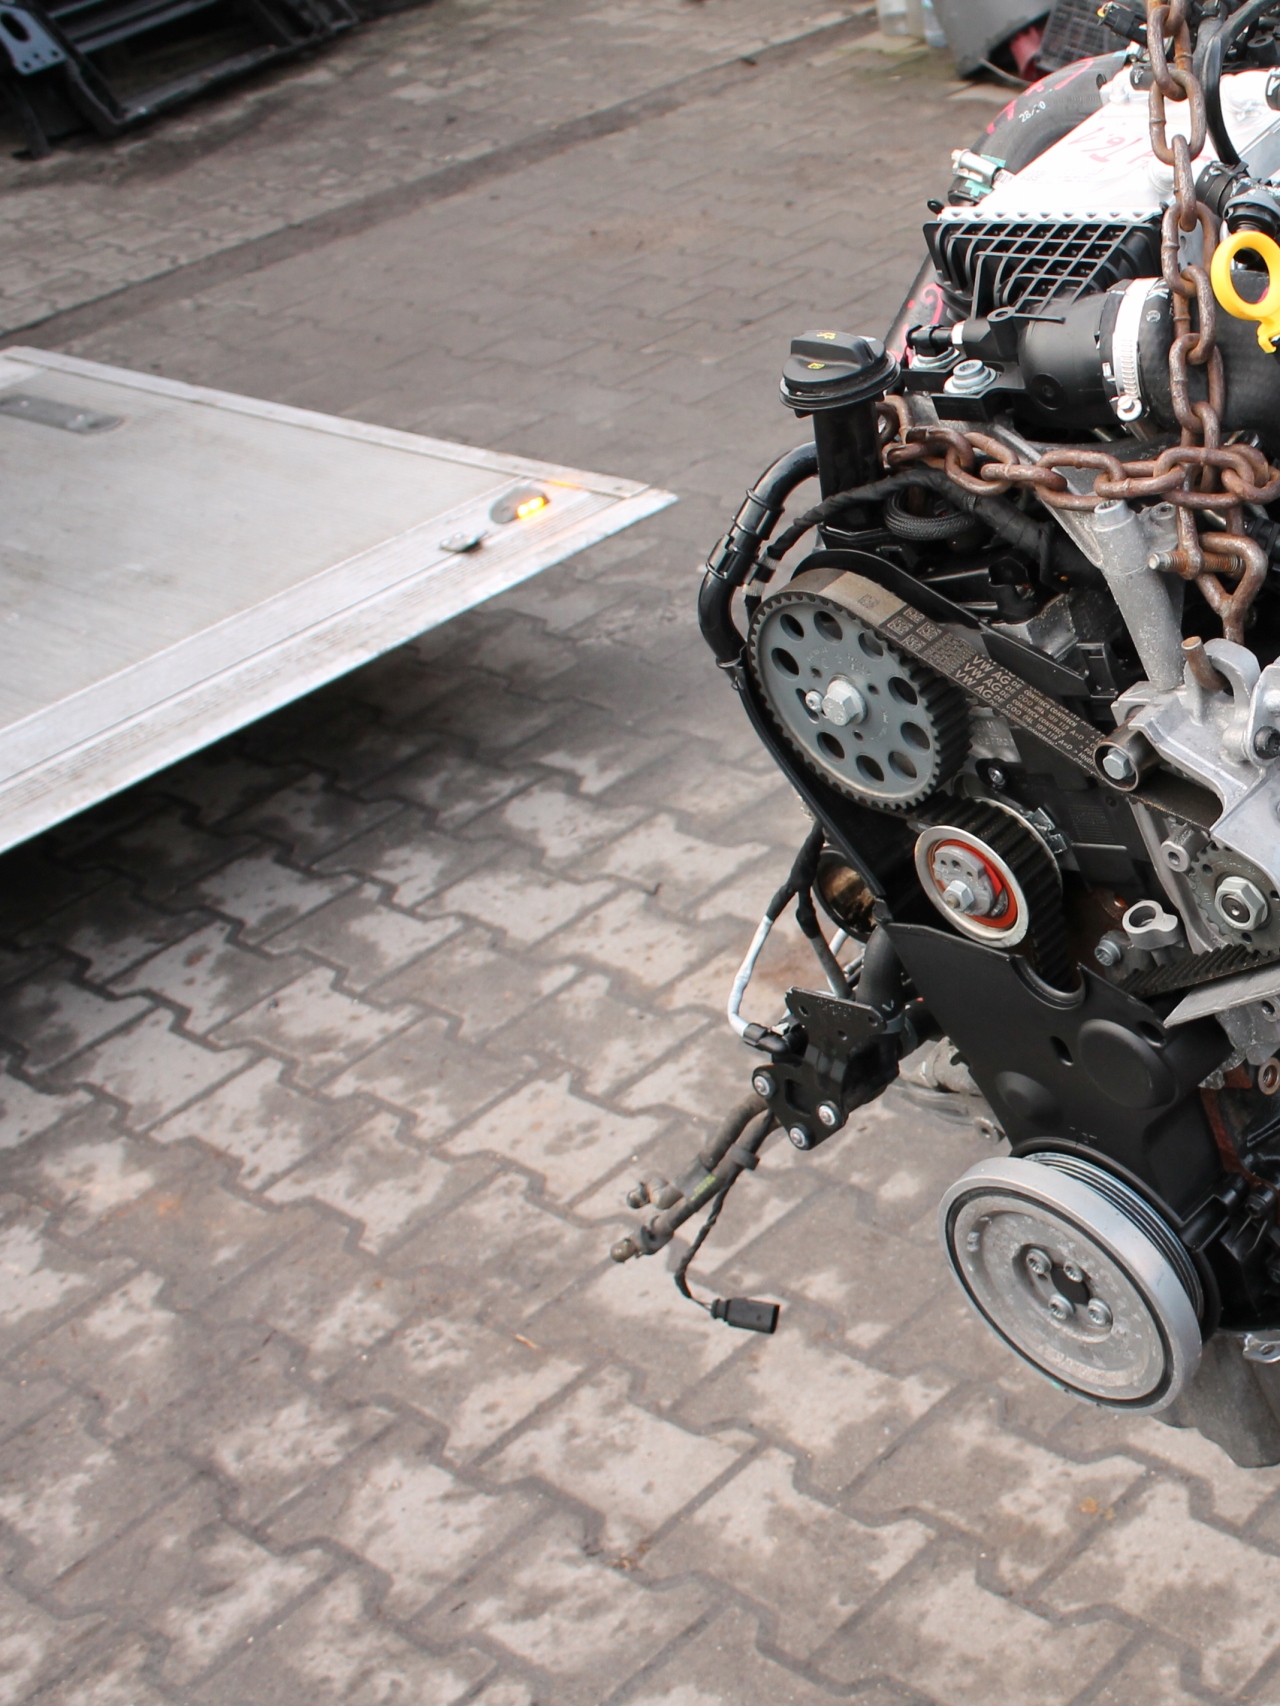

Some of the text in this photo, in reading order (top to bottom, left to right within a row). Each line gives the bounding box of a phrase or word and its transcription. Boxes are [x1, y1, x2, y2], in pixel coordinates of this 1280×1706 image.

[955, 669, 993, 700] VW AG
[963, 663, 1002, 692] VW AG
[971, 655, 1010, 686] VW AG
